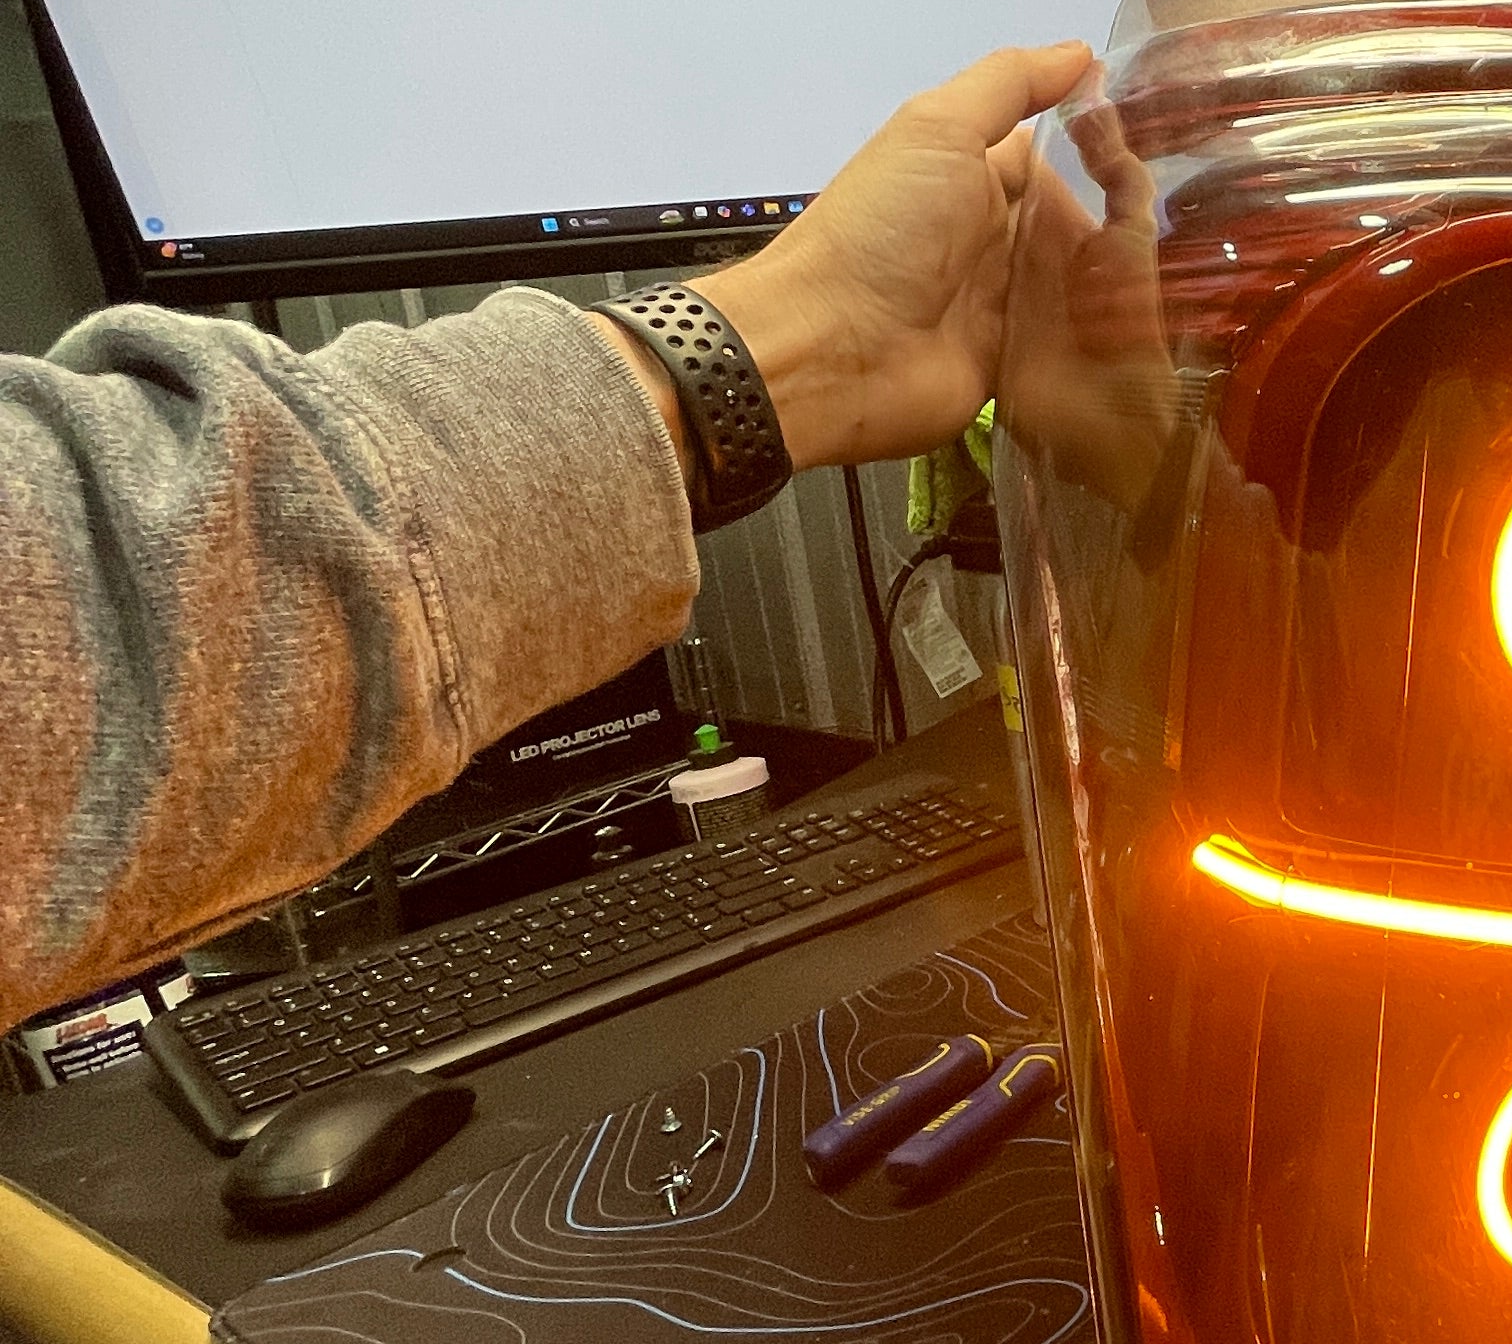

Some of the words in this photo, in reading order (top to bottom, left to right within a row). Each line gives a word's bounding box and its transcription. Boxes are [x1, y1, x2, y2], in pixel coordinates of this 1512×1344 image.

[510, 744, 541, 762] LED
[540, 719, 626, 755] PROJECTOR
[625, 708, 661, 730] LENS
